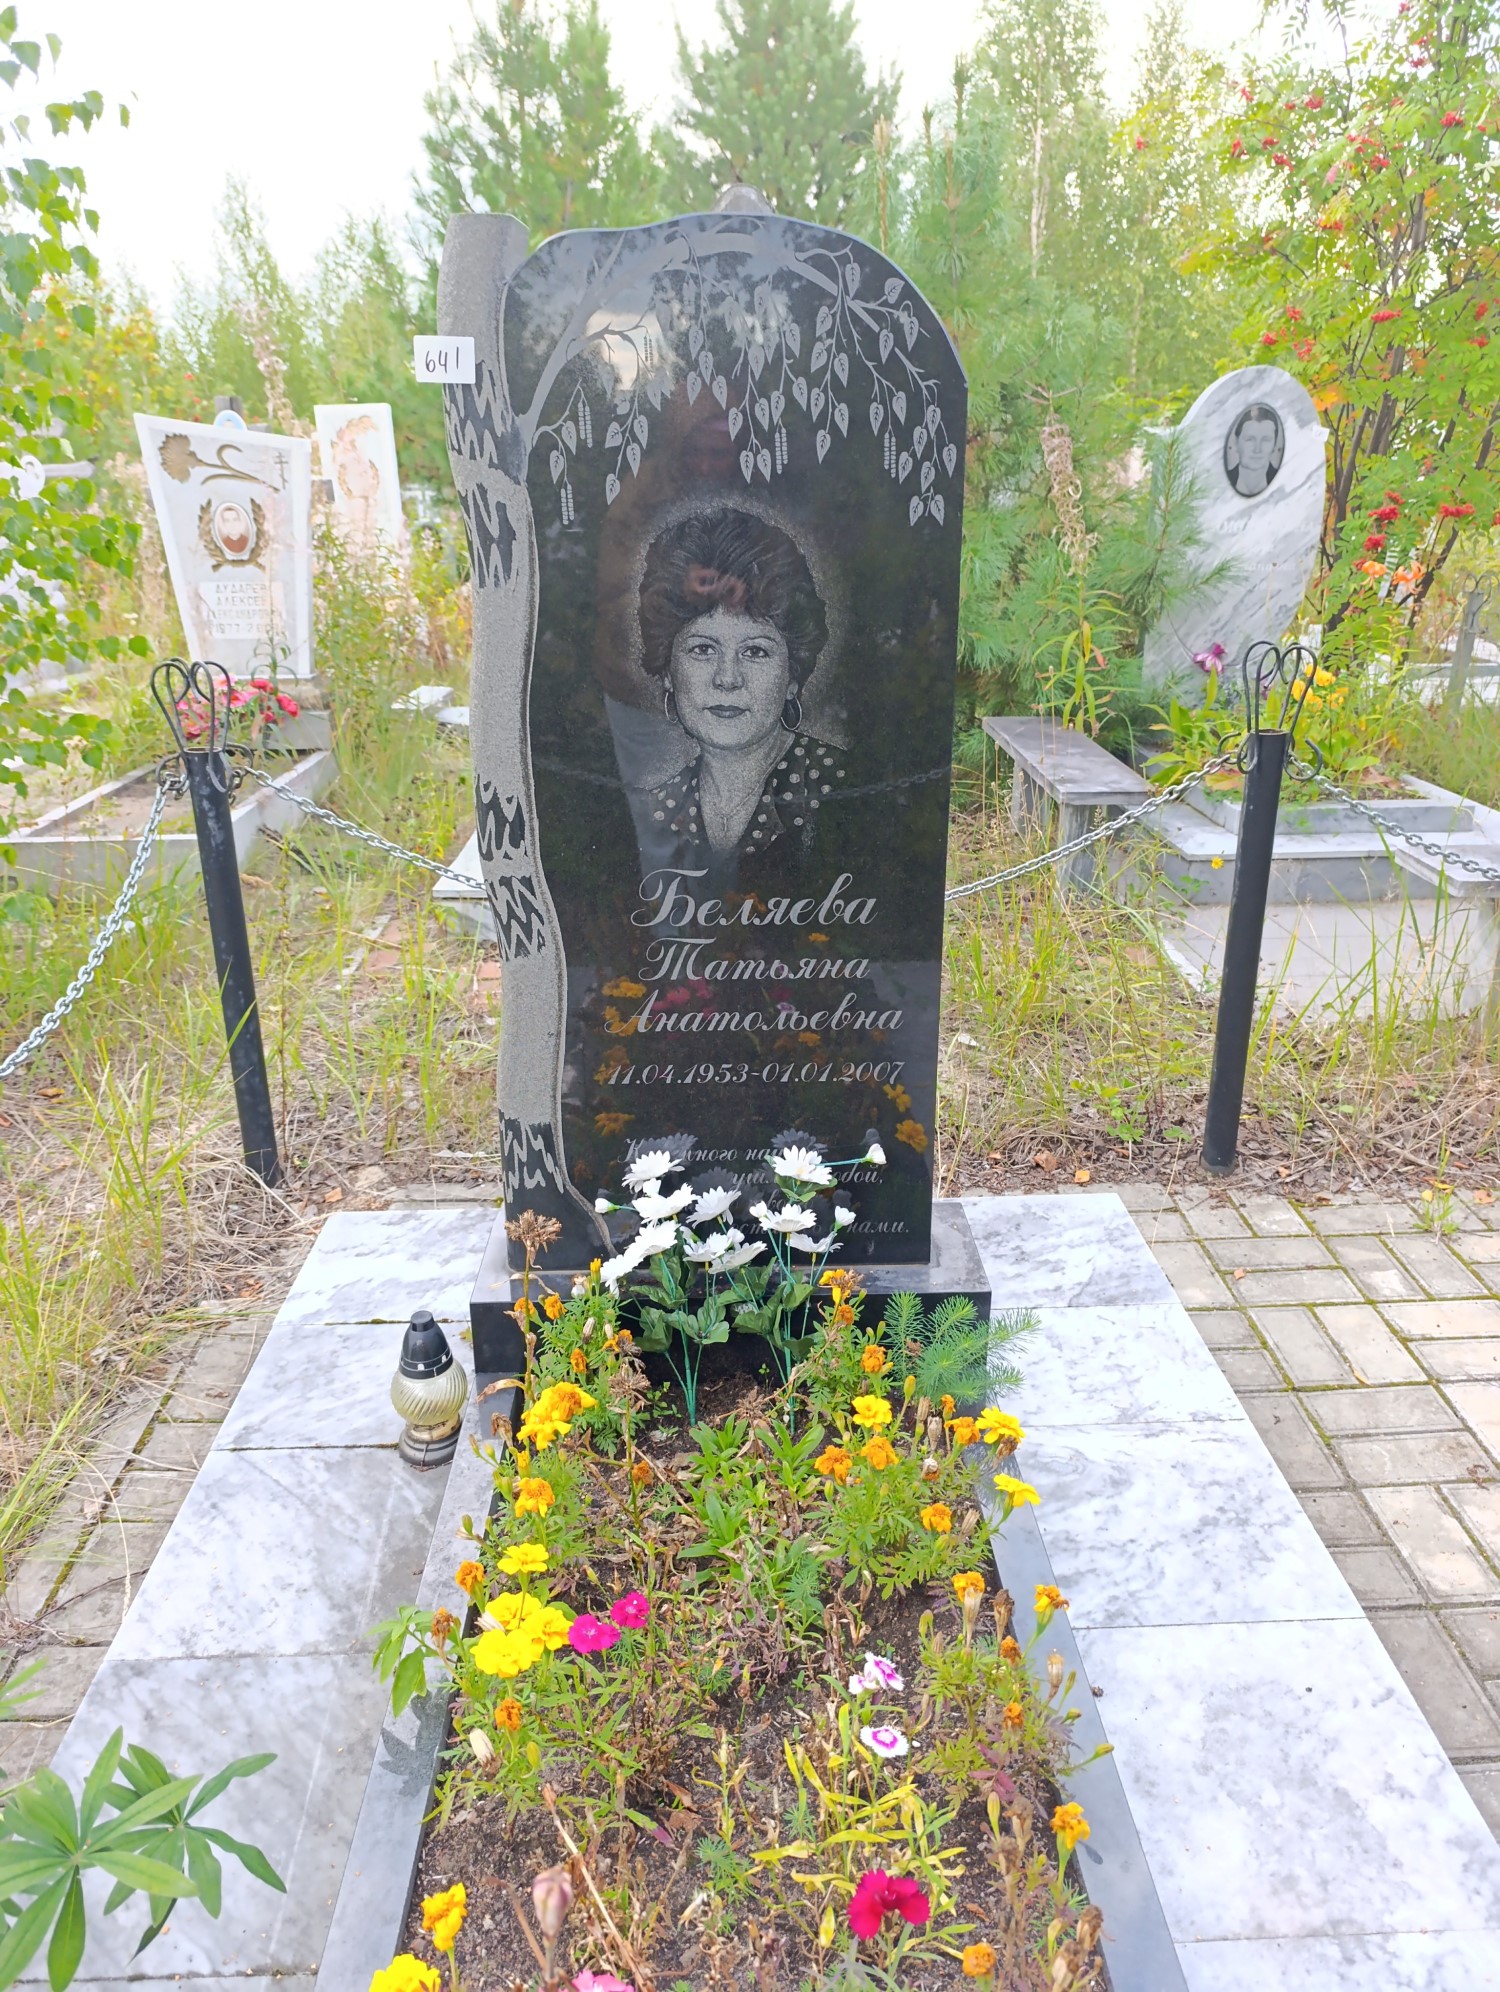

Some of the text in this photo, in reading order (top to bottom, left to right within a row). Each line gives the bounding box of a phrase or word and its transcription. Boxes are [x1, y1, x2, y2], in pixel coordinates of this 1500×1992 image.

[425, 346, 459, 374] 641
[631, 868, 878, 927] Беляева
[638, 937, 870, 981] Татьяна
[604, 989, 905, 1033] Анатольевна
[608, 1062, 906, 1085] 11.04.1953-01.01.2007
[834, 1162, 884, 1185] обой,
